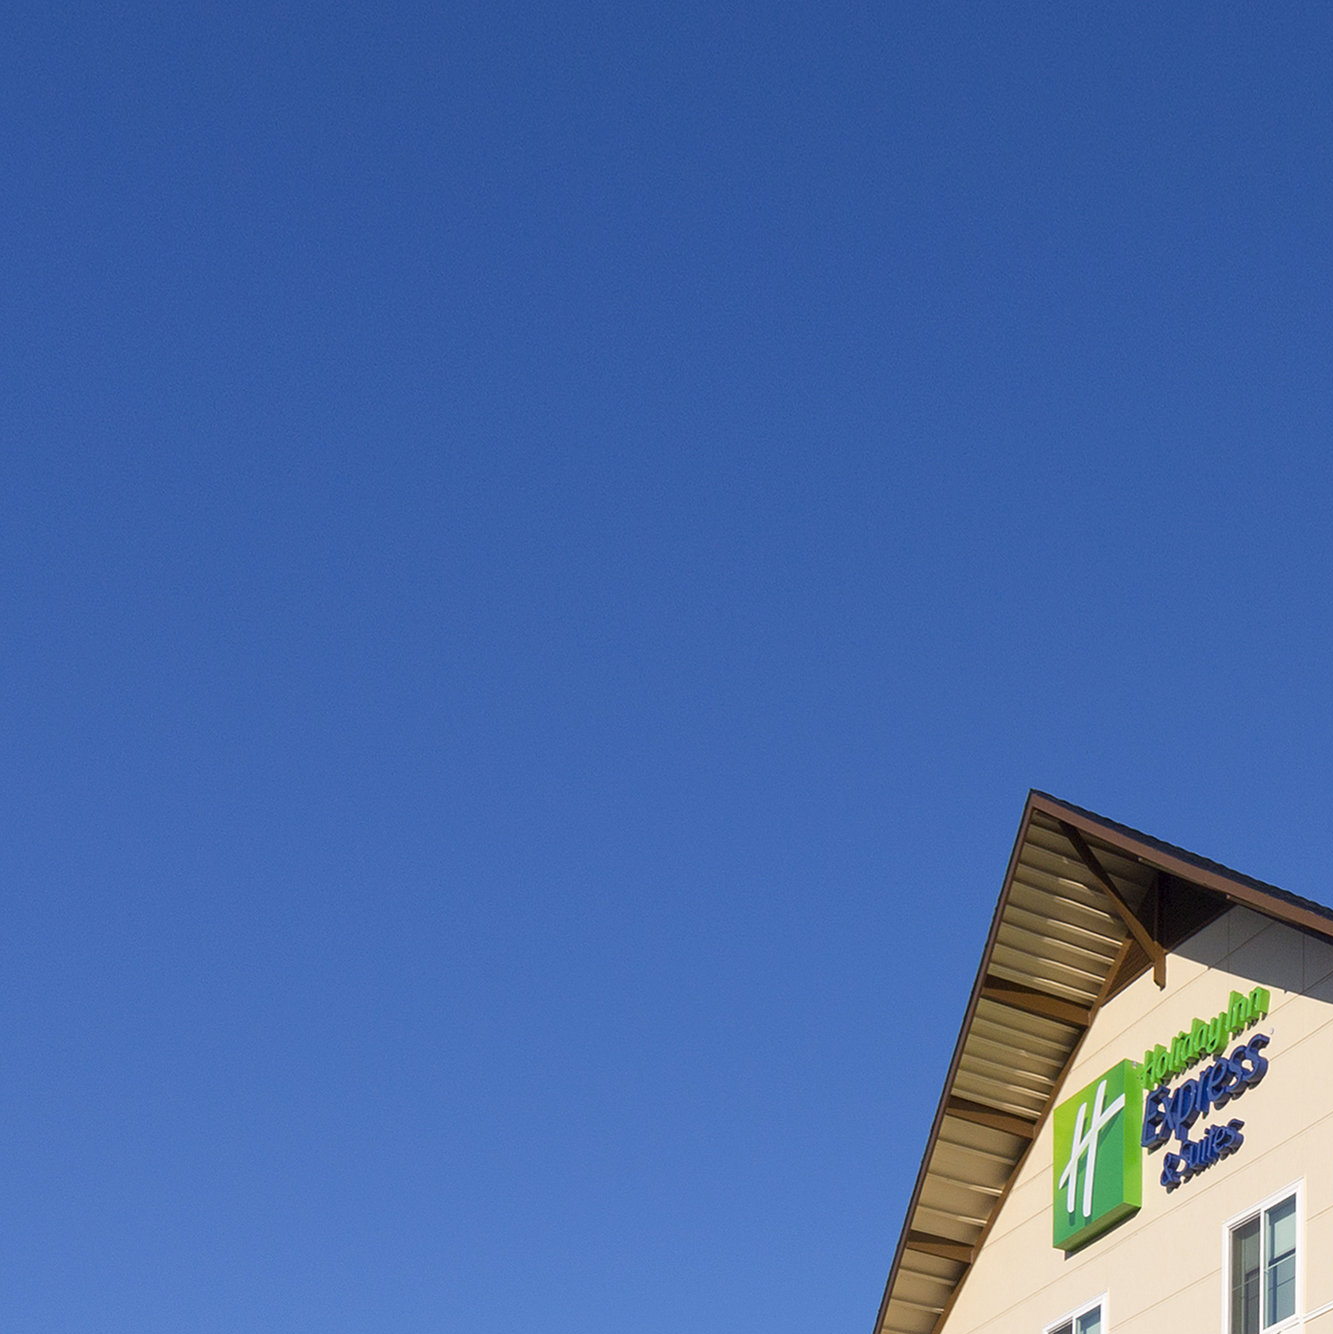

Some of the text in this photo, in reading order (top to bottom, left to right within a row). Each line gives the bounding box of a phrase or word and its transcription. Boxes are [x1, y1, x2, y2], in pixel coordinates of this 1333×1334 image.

[1225, 986, 1270, 1034] Inn
[1141, 1033, 1270, 1151] Express
[1160, 1119, 1245, 1188] & Suites
